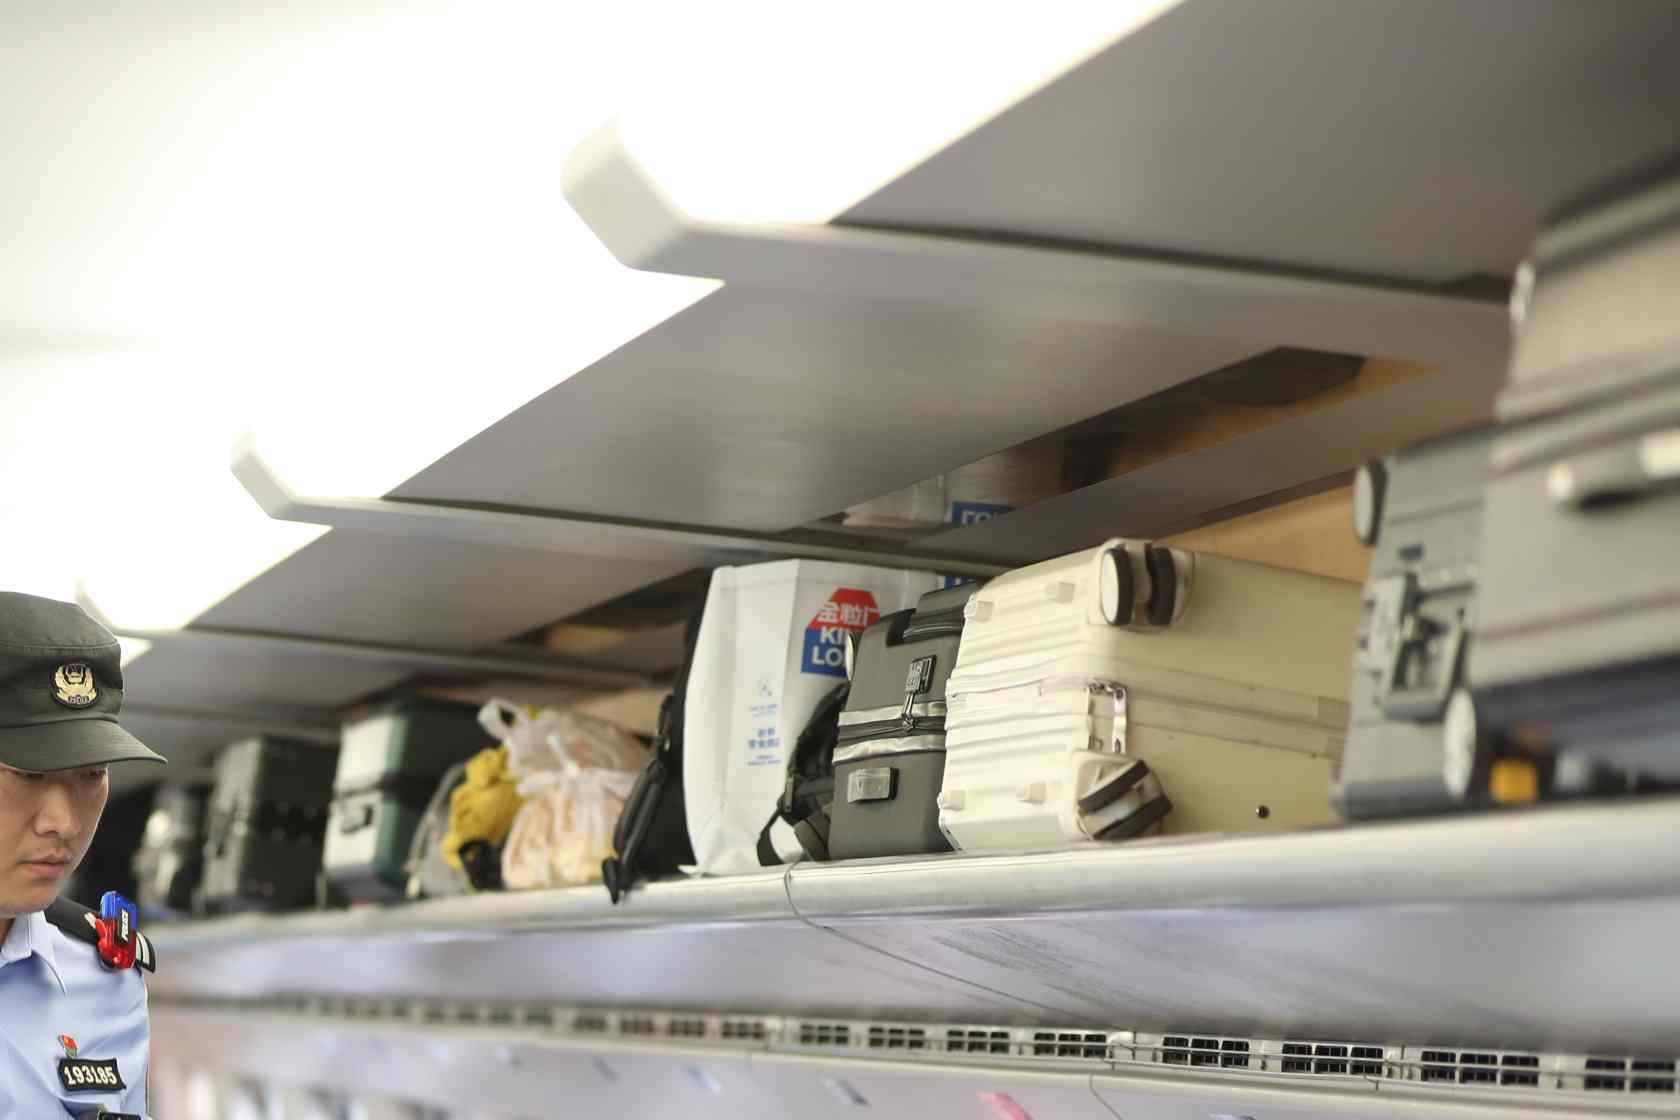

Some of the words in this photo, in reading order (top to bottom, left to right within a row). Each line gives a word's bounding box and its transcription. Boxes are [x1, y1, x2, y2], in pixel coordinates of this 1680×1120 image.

[819, 627, 844, 645] KI
[812, 646, 843, 667] LO
[63, 1065, 118, 1085] 193185
